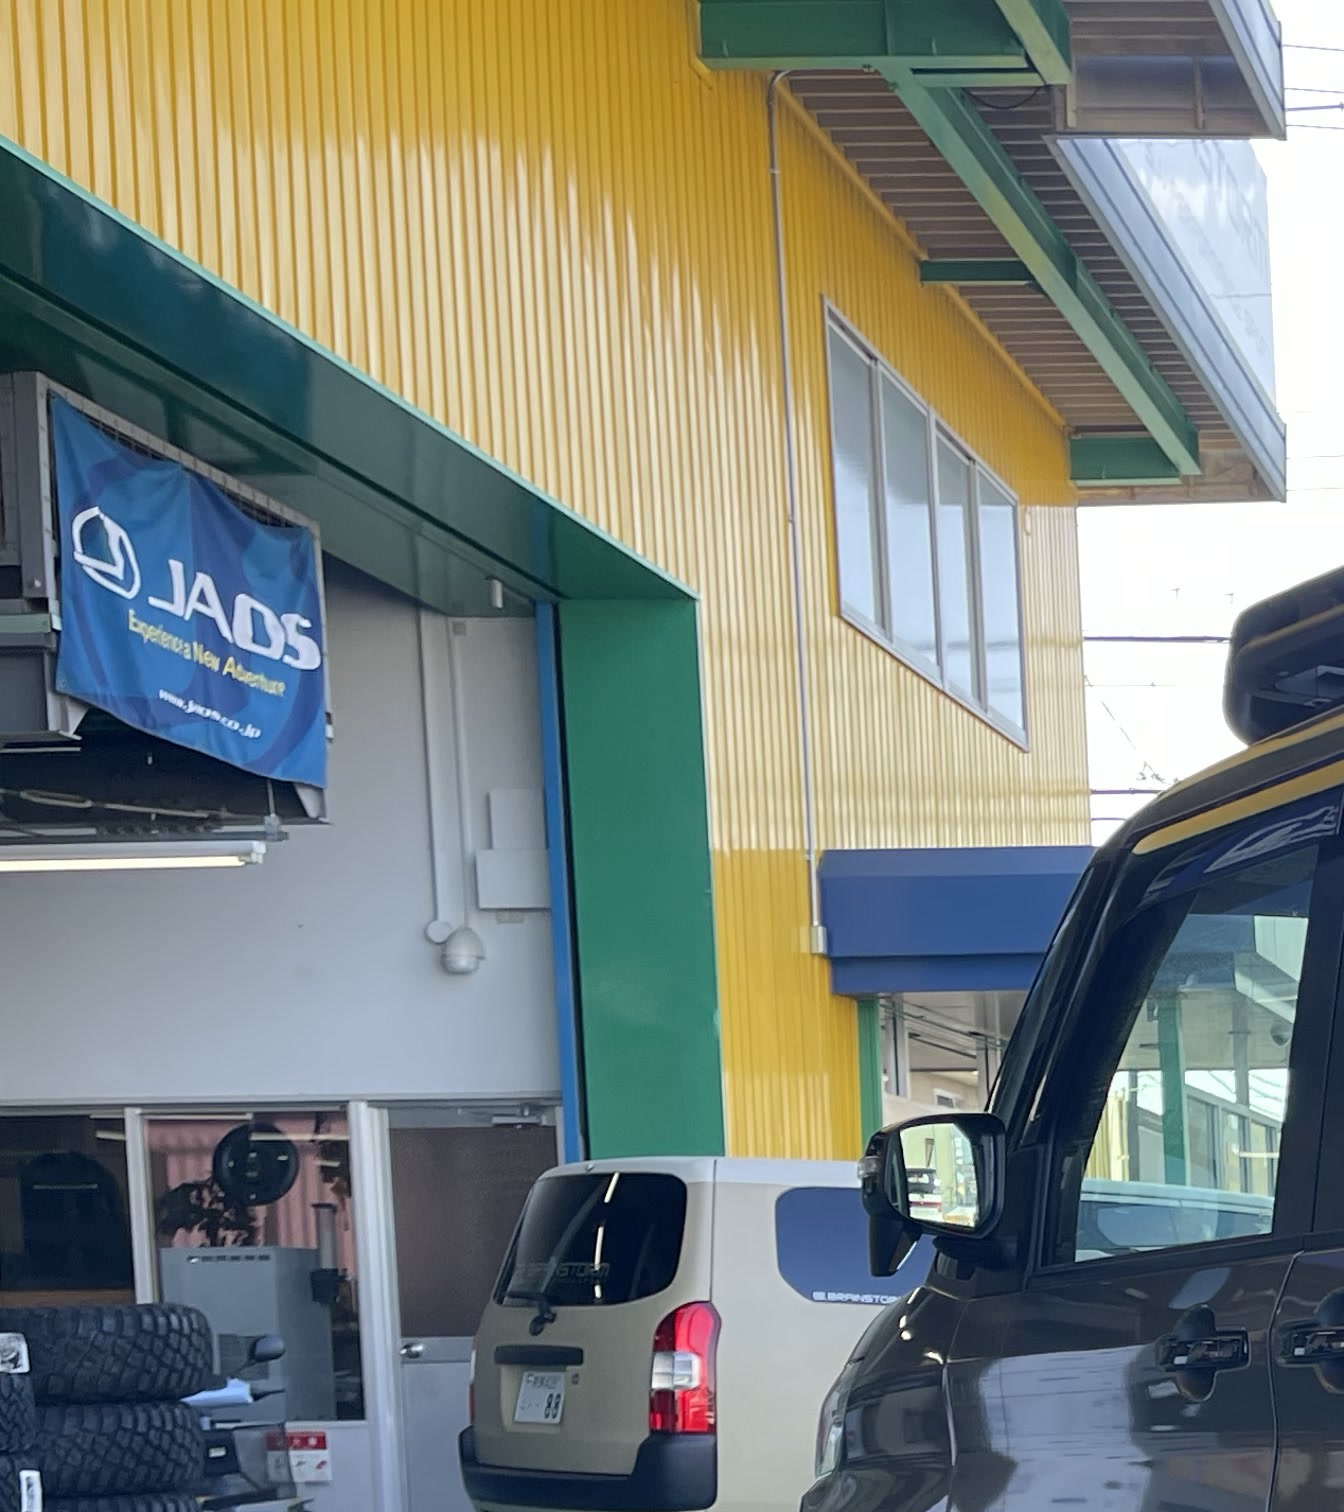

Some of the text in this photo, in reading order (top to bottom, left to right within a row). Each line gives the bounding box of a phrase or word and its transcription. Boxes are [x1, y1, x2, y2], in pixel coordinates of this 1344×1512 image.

[148, 559, 321, 670] JAOS
[193, 641, 220, 672] New
[222, 656, 286, 697] Adventure
